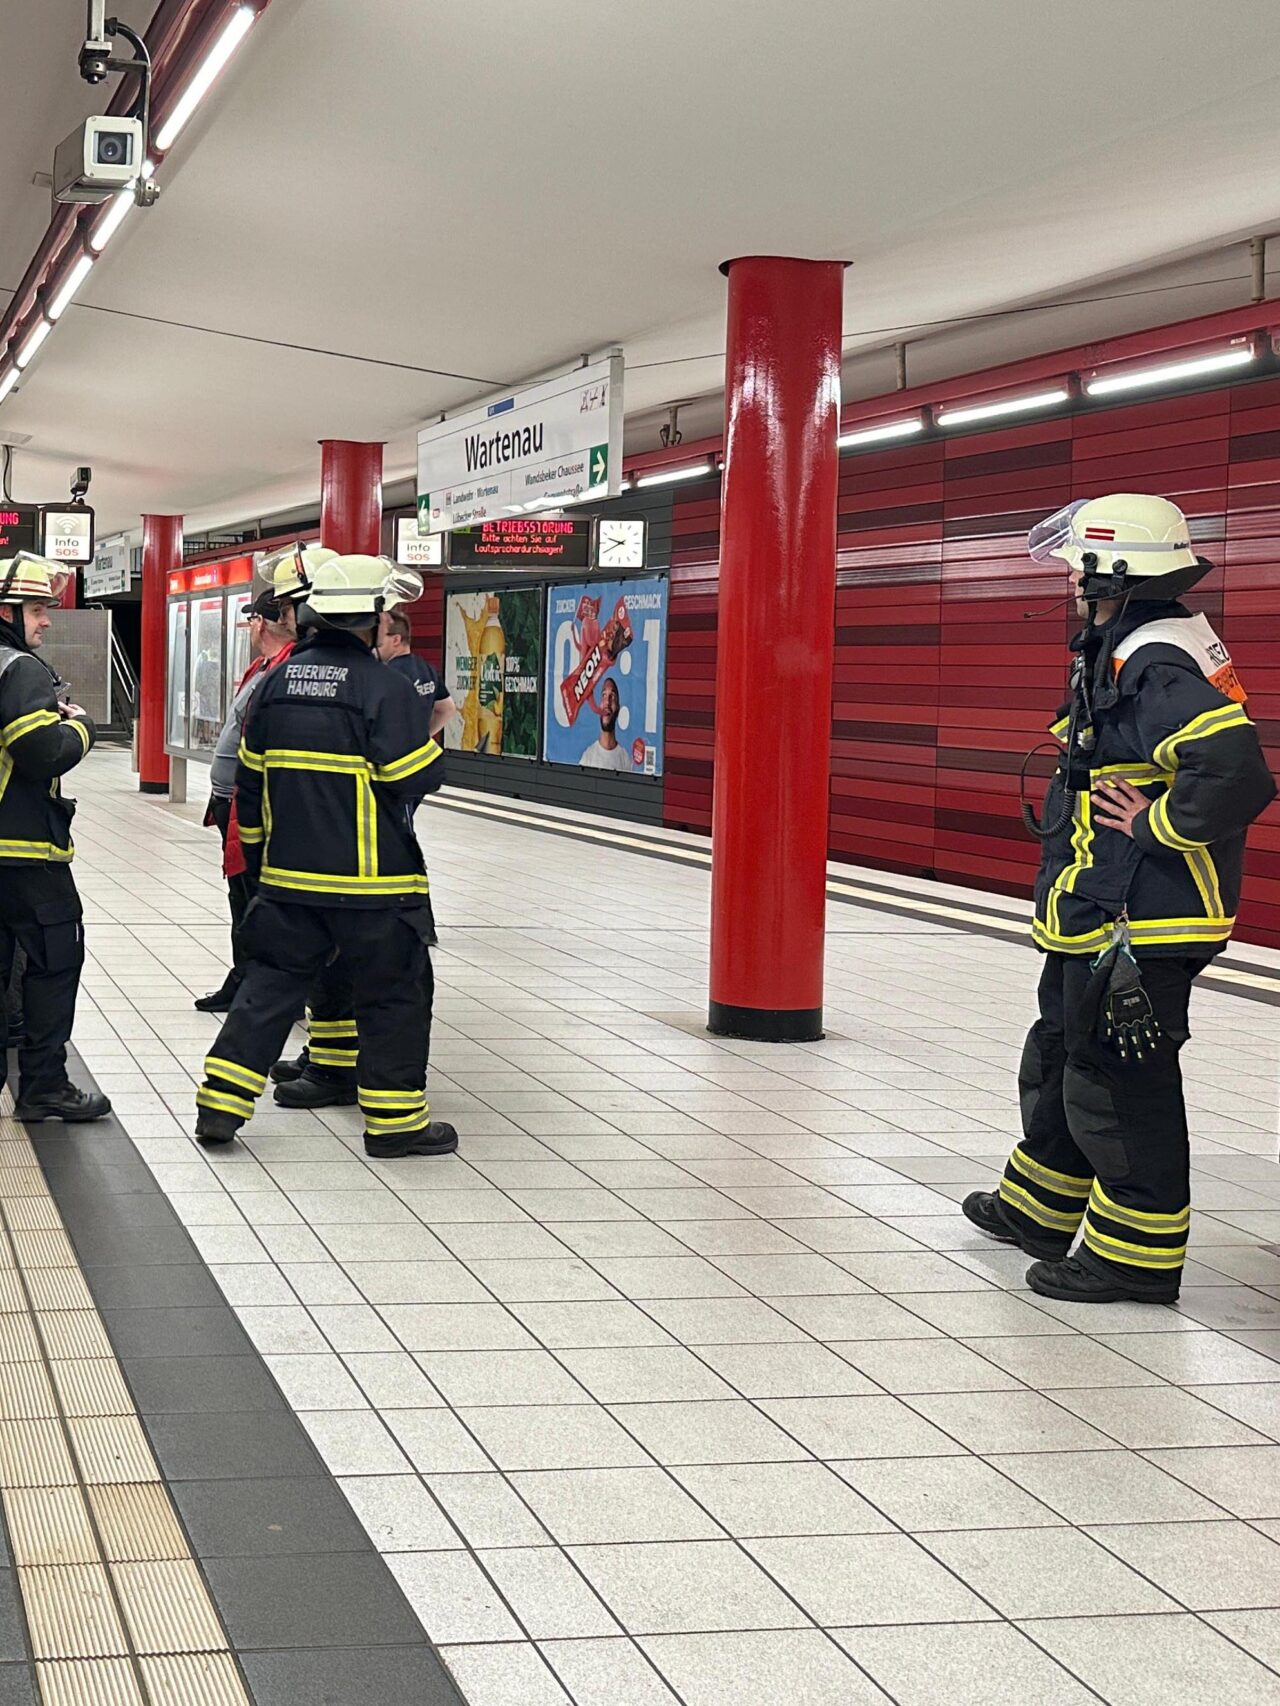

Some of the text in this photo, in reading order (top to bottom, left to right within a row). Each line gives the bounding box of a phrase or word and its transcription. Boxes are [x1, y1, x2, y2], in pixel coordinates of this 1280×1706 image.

[465, 422, 544, 472] Wartenau
[525, 461, 585, 487] Wandsbeker Chaussee
[55, 538, 79, 547] Info
[482, 534, 558, 543] Bitte achten Sie auf
[55, 548, 79, 556] SOS
[406, 543, 431, 553] Info
[406, 553, 431, 562] SOS
[624, 594, 662, 609] GESCHMACK
[285, 664, 349, 682] FEUERWEHR
[573, 646, 602, 701] NEOH
[287, 681, 338, 697] HAMBURG
